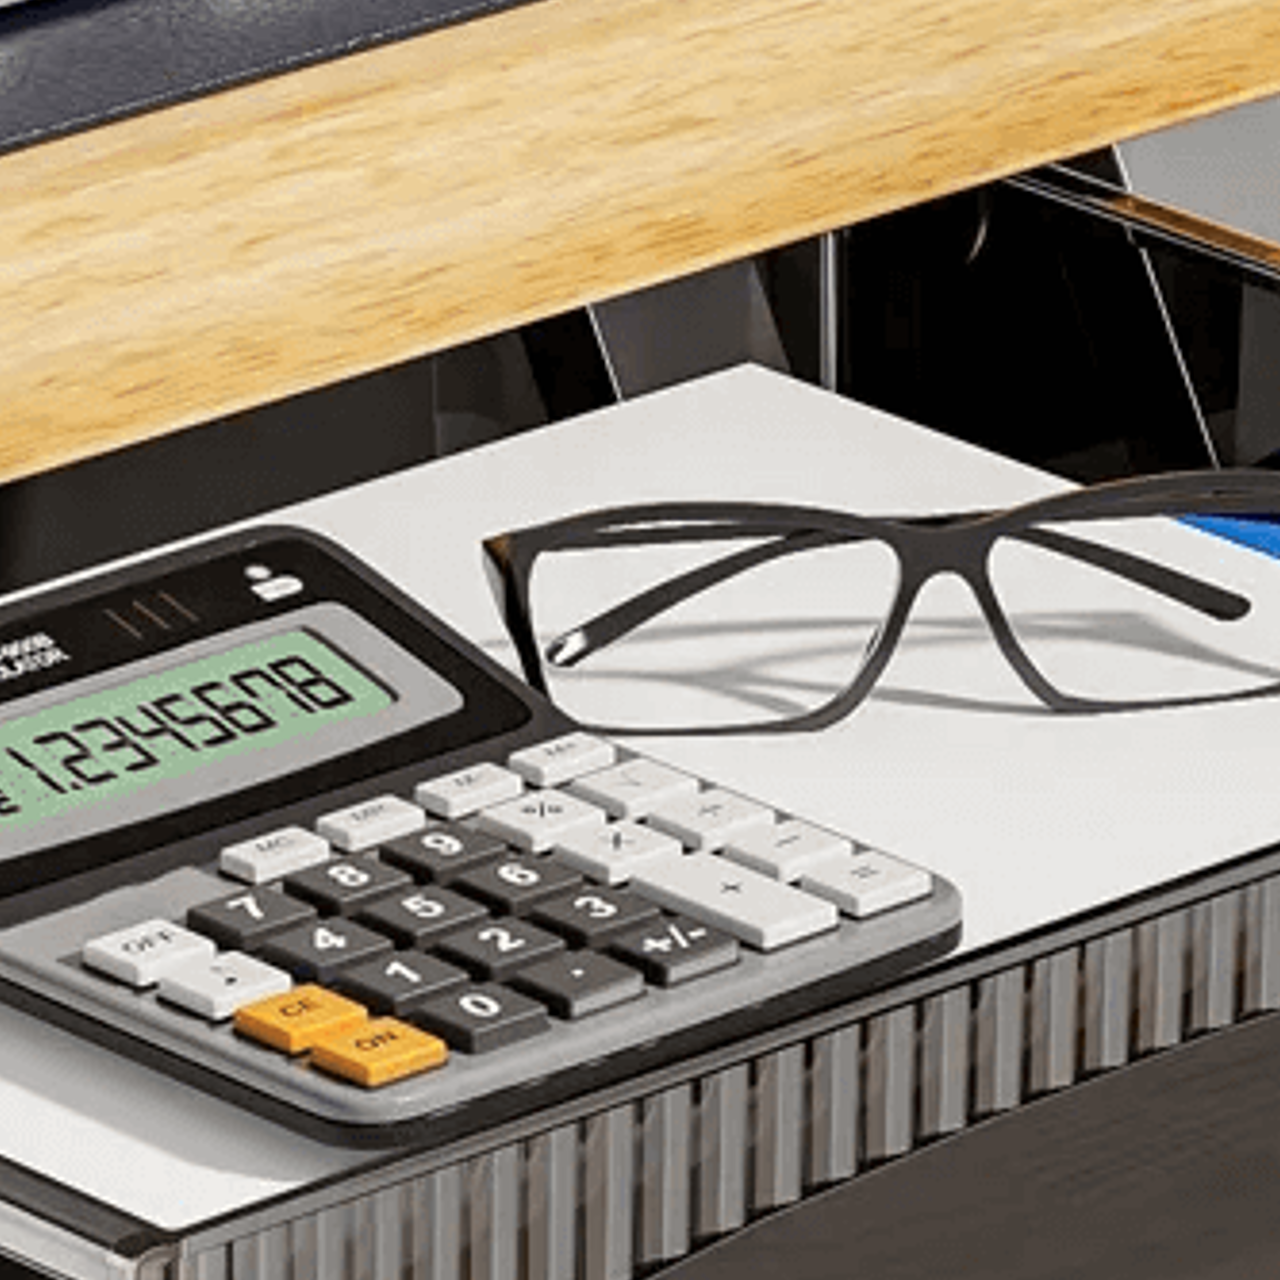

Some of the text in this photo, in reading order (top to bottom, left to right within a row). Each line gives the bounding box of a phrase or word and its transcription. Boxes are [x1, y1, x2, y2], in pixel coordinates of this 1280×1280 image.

[5, 654, 355, 795] 1.2345678
[421, 832, 463, 856] 9
[327, 863, 370, 887] 8
[497, 861, 540, 885] 6
[226, 894, 265, 921] 7
[401, 894, 445, 919] 5
[573, 895, 618, 918] 3
[122, 928, 176, 954] OFF
[312, 926, 347, 950] 4
[477, 926, 526, 952] 2
[385, 960, 422, 984] 1
[458, 992, 502, 1017] 0
[353, 1029, 400, 1052] ON
